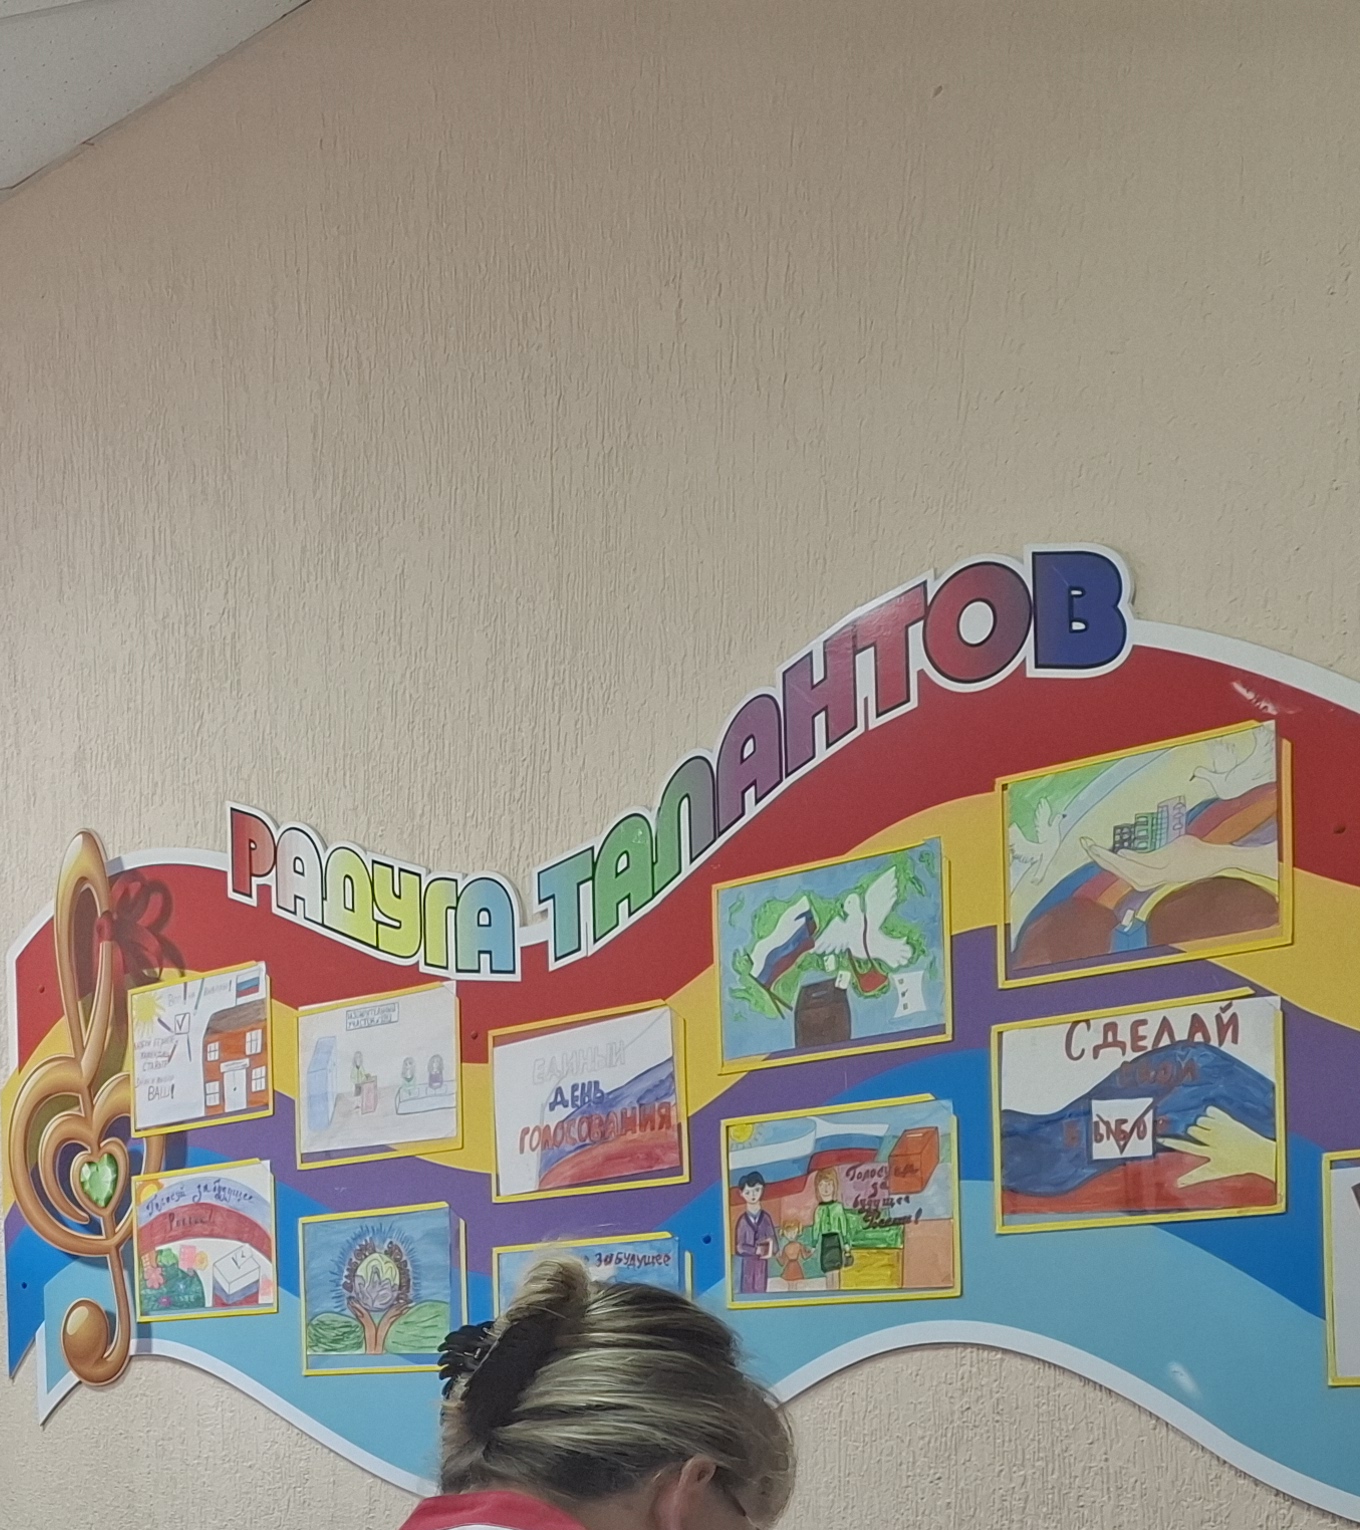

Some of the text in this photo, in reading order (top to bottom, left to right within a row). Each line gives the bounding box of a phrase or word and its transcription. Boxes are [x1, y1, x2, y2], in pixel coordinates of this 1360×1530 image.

[231, 551, 1126, 974] РАДУГА ТАЛАНТОВ
[1065, 1001, 1239, 1061] СДЕЛАЙ
[549, 1080, 605, 1112] ДЕНЬ
[519, 1101, 672, 1154] ГОЛОСОВАНИЯ
